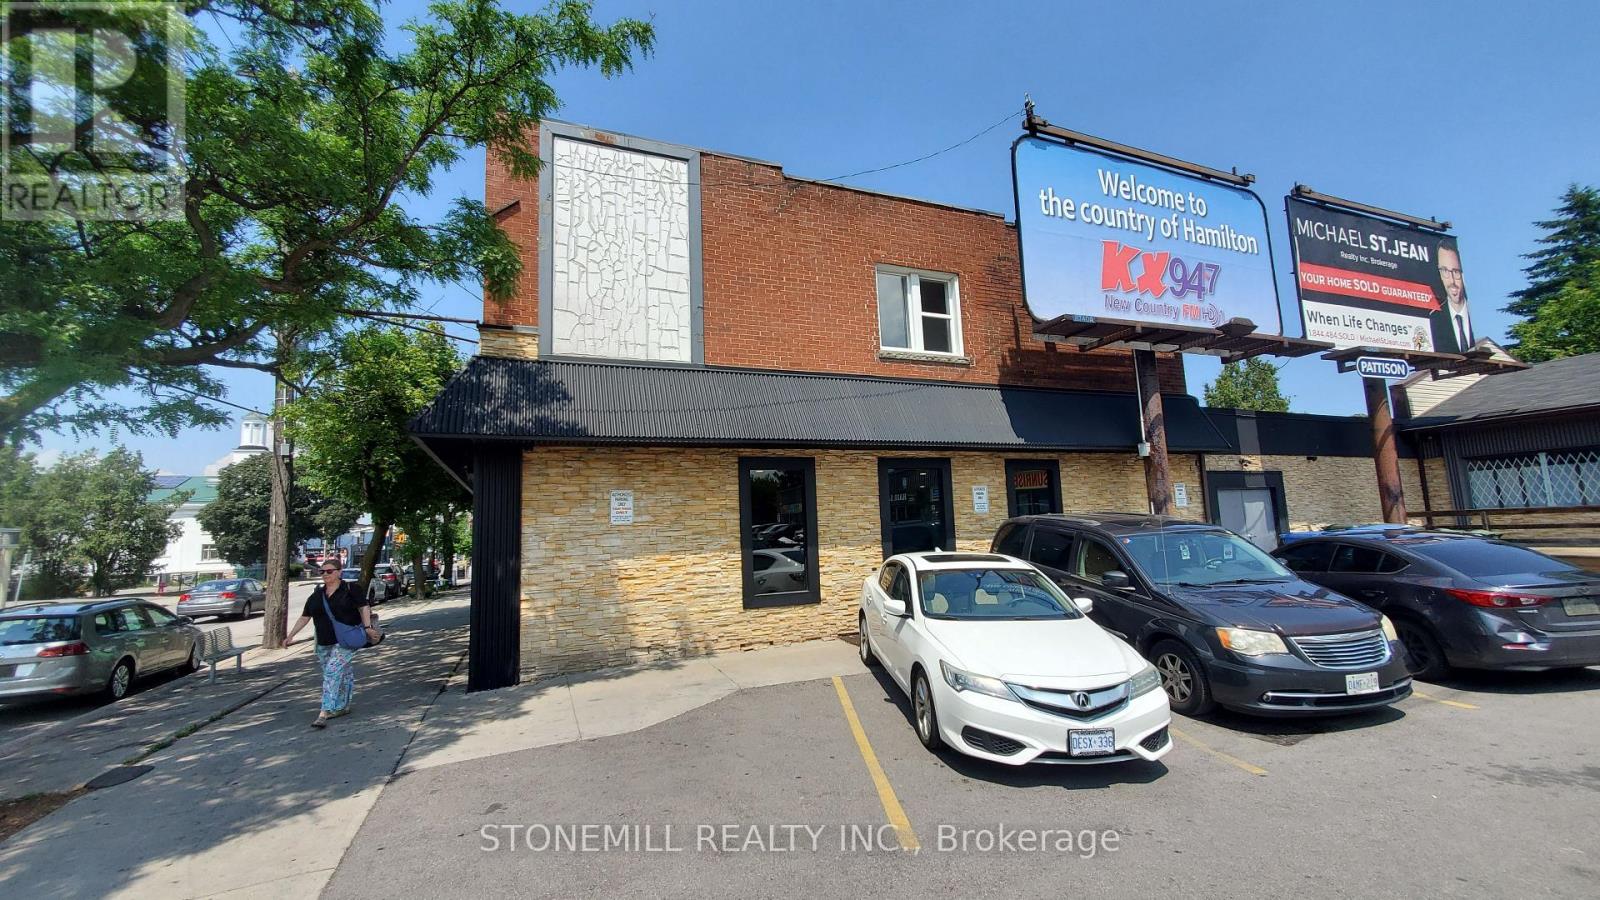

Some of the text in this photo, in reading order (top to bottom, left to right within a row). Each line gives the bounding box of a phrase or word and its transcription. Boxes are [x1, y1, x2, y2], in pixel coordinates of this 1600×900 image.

[1098, 169, 1208, 217] Welcome to
[1039, 187, 1259, 255] the country of Hamilton
[1296, 217, 1430, 263] MICHAEL ST.JEAN
[1340, 250, 1359, 263] Realty
[1370, 257, 1398, 270] Brokerage
[1300, 271, 1326, 286] YOUR
[1327, 276, 1353, 290] HOME
[1354, 278, 1380, 294] SOLD
[1104, 294, 1130, 312] New
[1134, 298, 1179, 319] Country
[1182, 303, 1200, 320] FM
[1306, 310, 1340, 327] When
[1342, 315, 1363, 330] Life
[1360, 361, 1406, 376] PATTISON
